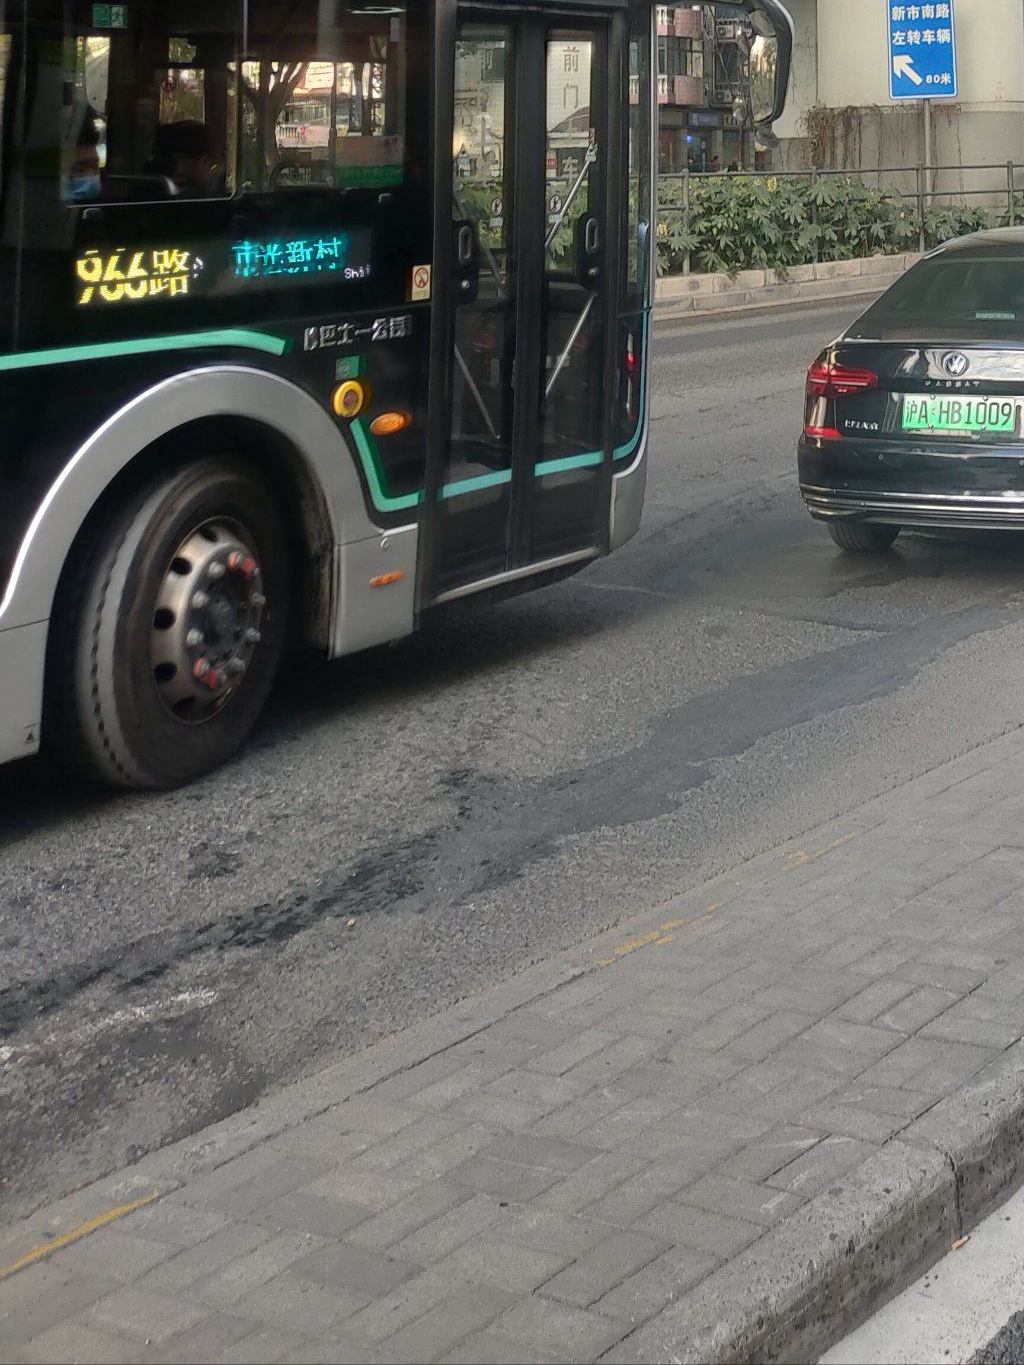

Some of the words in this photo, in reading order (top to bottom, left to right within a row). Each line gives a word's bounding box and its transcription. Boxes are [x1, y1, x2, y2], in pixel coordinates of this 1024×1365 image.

[891, 2, 950, 21] 新市南路
[891, 27, 951, 46] 左转车辆
[75, 247, 191, 305] 966路
